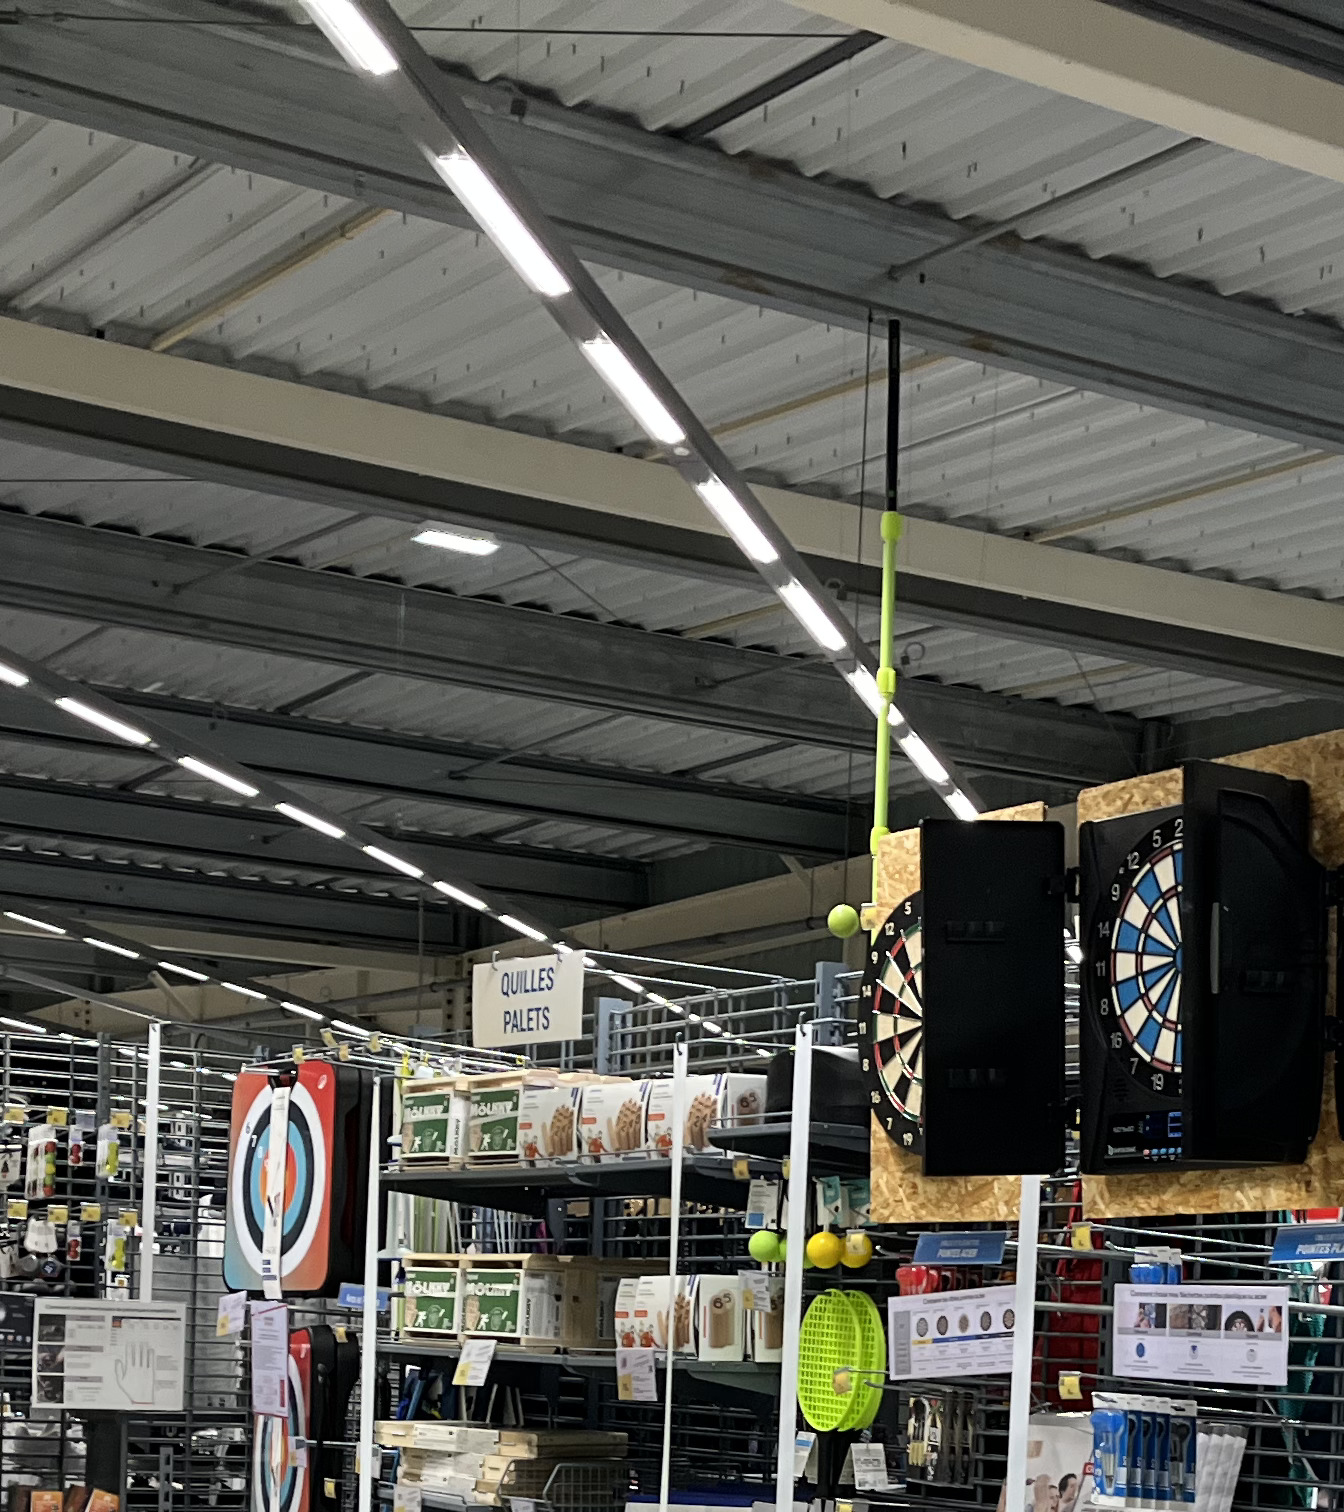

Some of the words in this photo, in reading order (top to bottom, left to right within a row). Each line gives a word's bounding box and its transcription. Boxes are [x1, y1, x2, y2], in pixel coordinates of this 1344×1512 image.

[1153, 829, 1162, 848] 5
[1126, 851, 1140, 870] 12
[1111, 884, 1120, 901] 9
[885, 922, 895, 936] 12
[1098, 921, 1110, 938] 14
[1096, 960, 1106, 976] 11
[500, 967, 555, 996] QUILLES
[1100, 998, 1109, 1016] 8
[503, 1006, 551, 1035] PALETS
[1110, 1032, 1122, 1049] 16
[1130, 1057, 1139, 1075] 7
[1151, 1074, 1164, 1091] 19
